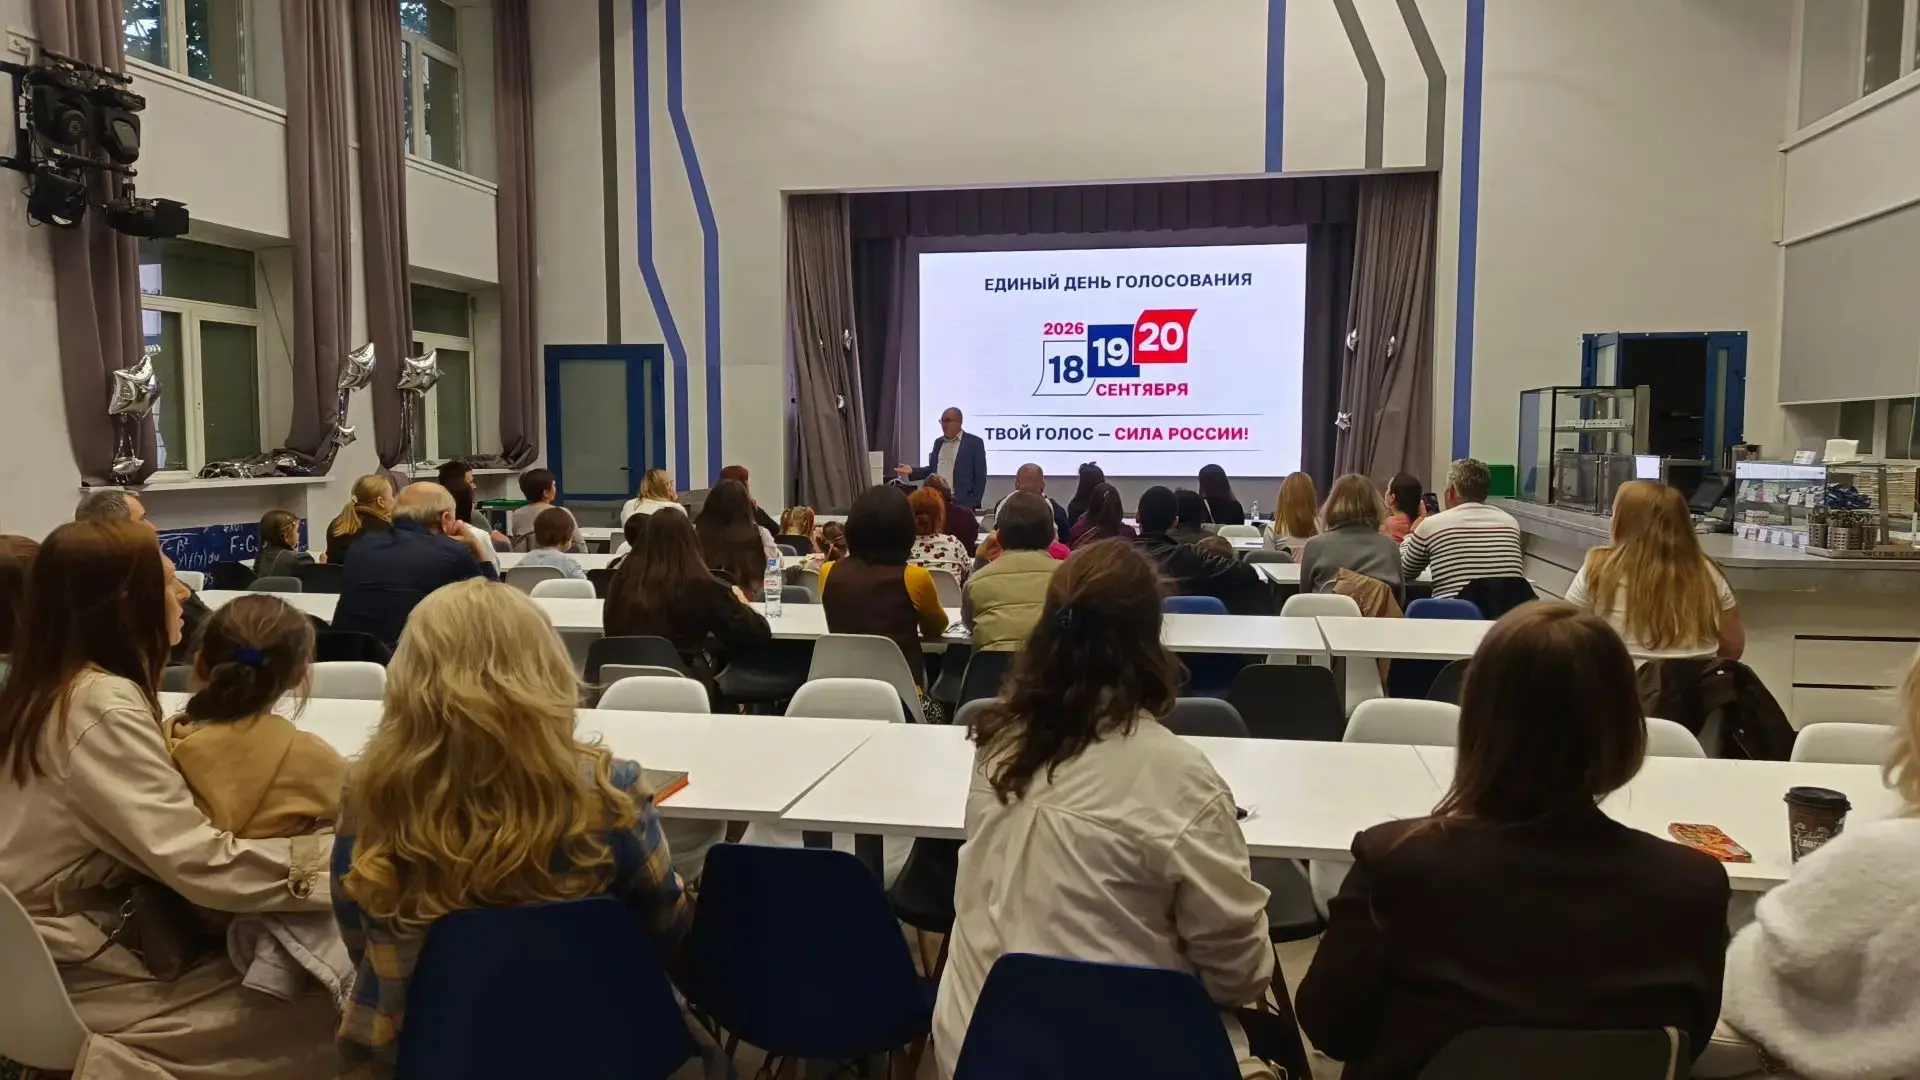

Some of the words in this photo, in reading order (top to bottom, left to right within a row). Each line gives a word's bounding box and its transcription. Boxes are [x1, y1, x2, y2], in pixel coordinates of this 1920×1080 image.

[984, 273, 1060, 293] ЕДИНЫЙ
[1063, 275, 1112, 292] ДЕНЬ
[1116, 272, 1253, 289] ГОЛОСОВАНИЯ
[1043, 321, 1085, 336] 2026
[1138, 321, 1184, 352] 20
[1092, 337, 1130, 367] 19
[1048, 355, 1085, 384] 18
[1095, 382, 1189, 397] СЕНТЯБРЯ
[984, 423, 1031, 441] ТВОЙ
[1036, 427, 1094, 441] ГОЛОС
[1114, 427, 1164, 441] СИЛА
[1168, 427, 1250, 441] РОССИИ!
